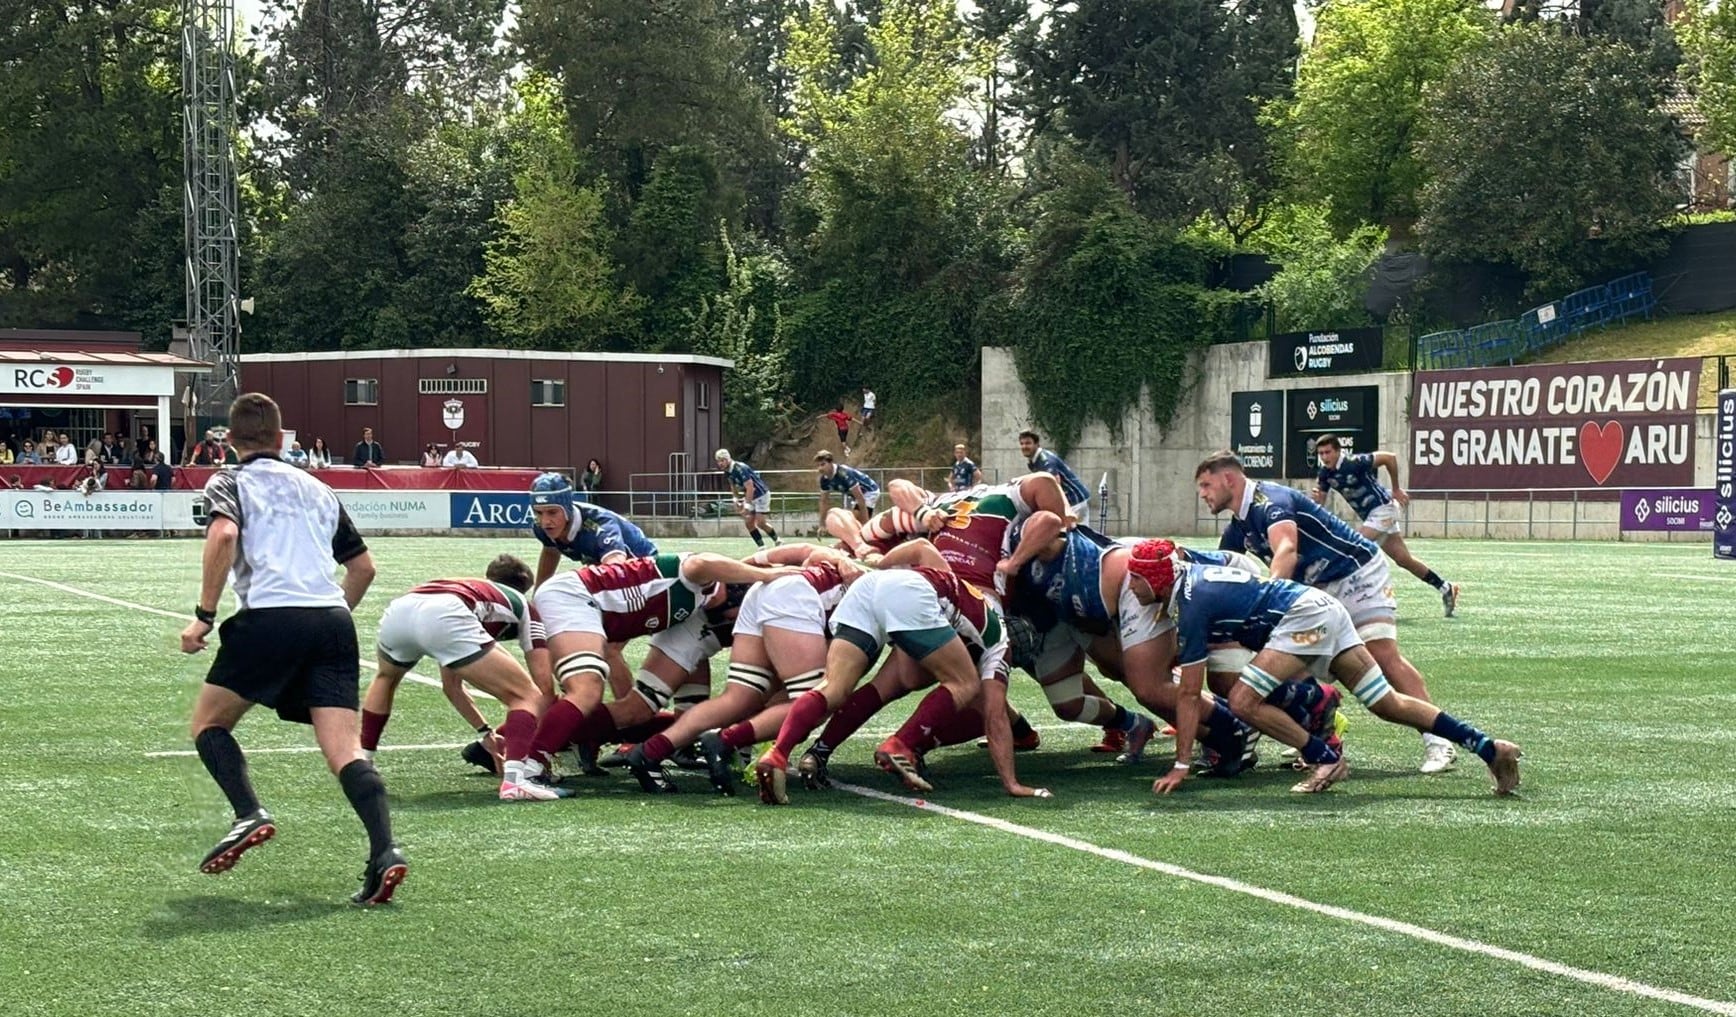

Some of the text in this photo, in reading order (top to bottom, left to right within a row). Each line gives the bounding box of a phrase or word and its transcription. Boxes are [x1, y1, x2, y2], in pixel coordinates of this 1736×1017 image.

[1309, 343, 1354, 355] ALCOBENDAS
[1309, 357, 1332, 368] RUGBY
[15, 367, 62, 388] RCS
[1418, 360, 1691, 418] NUESTRO CORAZÓN
[1415, 425, 1689, 466] ES GRANATE ARU
[1718, 399, 1735, 498] silicius
[43, 499, 154, 512] BeAmbassador
[344, 501, 426, 512] ndación NUMA
[1655, 495, 1700, 513] silicius
[1203, 565, 1252, 583] 6
